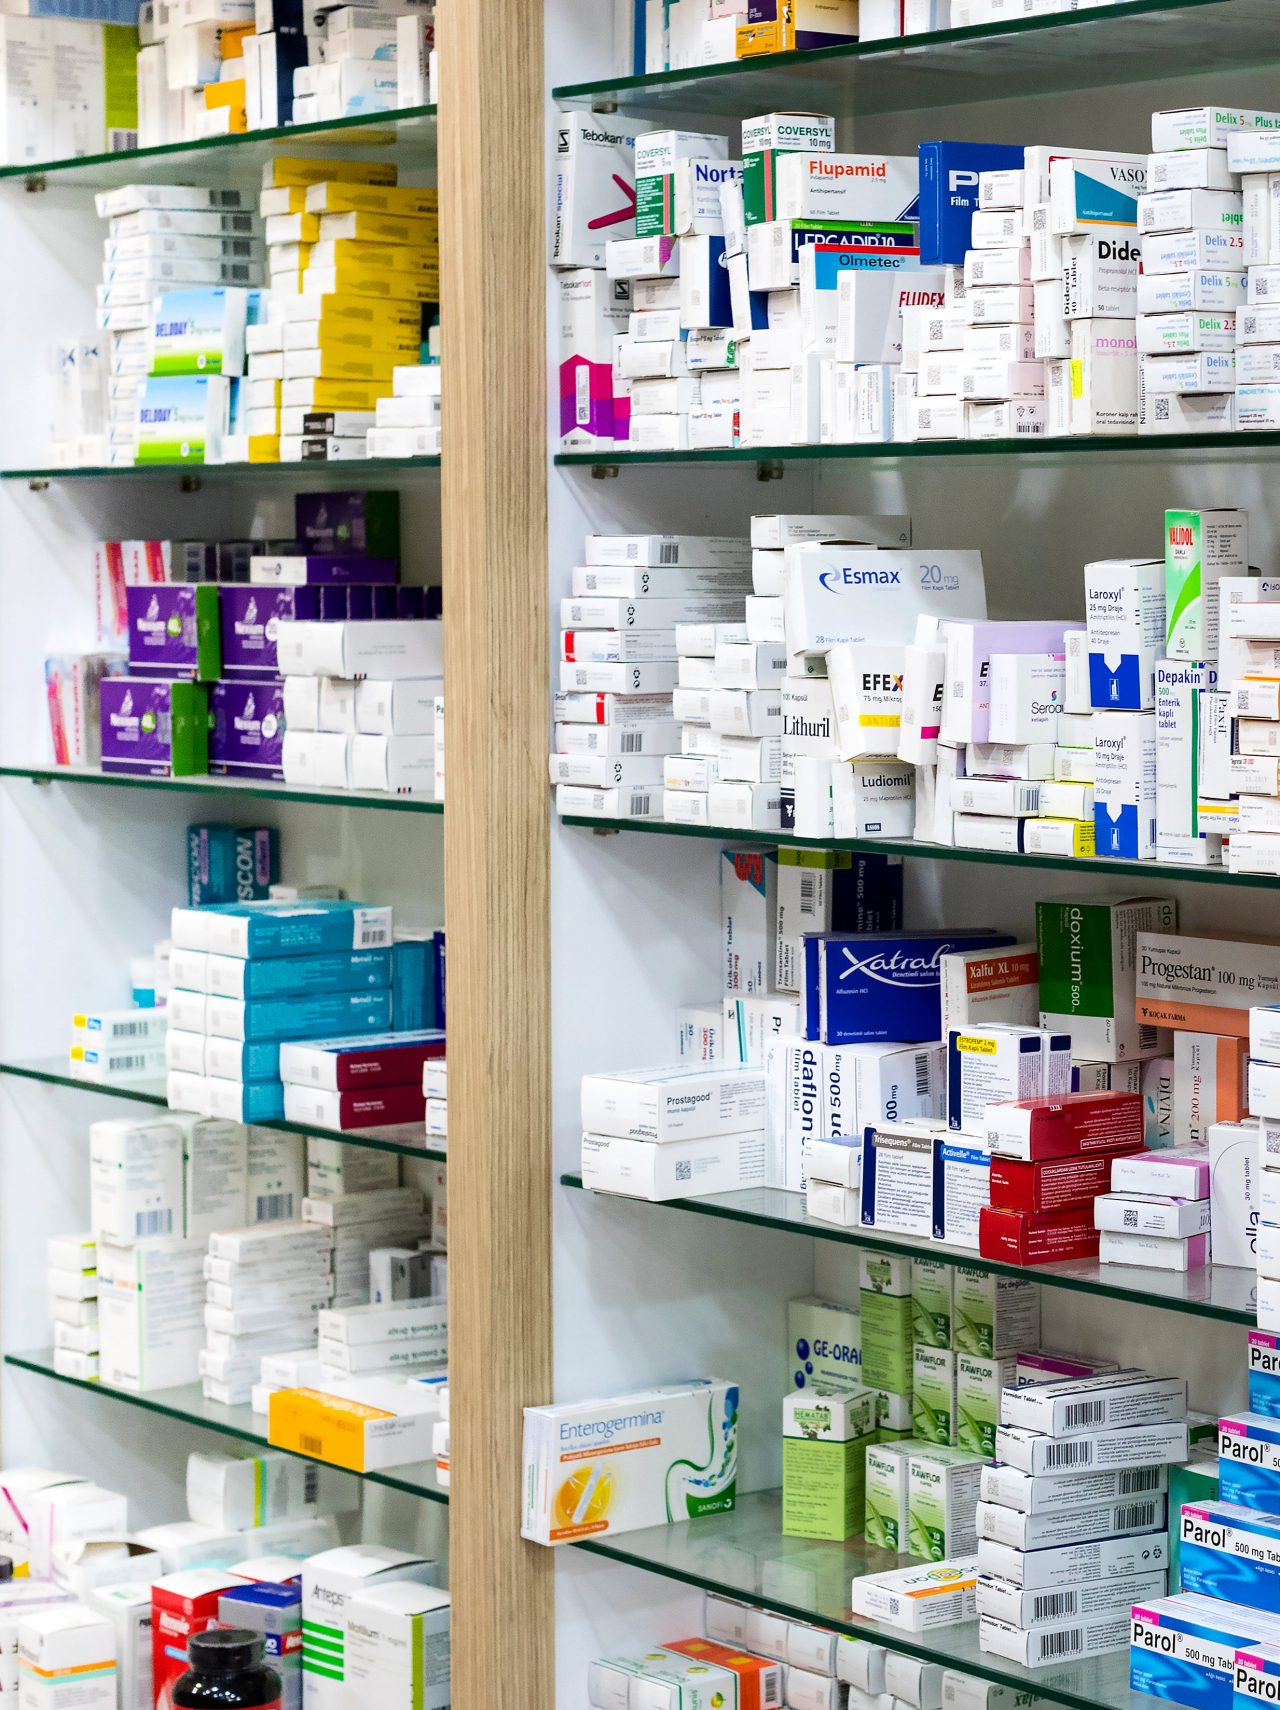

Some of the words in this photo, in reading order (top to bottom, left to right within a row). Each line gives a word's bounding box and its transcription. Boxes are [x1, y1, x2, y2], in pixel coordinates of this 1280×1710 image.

[1215, 112, 1237, 125] Delix
[1240, 115, 1245, 125] 5
[1255, 116, 1272, 128] Plus
[581, 129, 623, 145] Tebokan
[777, 125, 831, 137] COVERSYL
[809, 138, 817, 147] 10
[819, 140, 831, 149] mg
[636, 147, 671, 160] COVERSYL
[809, 160, 886, 178] Flupamid
[950, 196, 969, 206] Film
[553, 214, 562, 259] Tebokan
[1205, 235, 1227, 246] Delix
[1229, 237, 1243, 248] 2.5
[1098, 240, 1141, 261] Dide
[839, 254, 901, 268] Olmetec
[1200, 275, 1222, 287] Delix
[1225, 276, 1231, 287] 5
[1063, 267, 1071, 315] Dideral
[1199, 318, 1221, 330] Delix
[1206, 356, 1229, 367] Delix
[842, 567, 901, 585] Esmax
[919, 564, 942, 584] 20
[943, 574, 959, 586] mg
[1089, 587, 1122, 601] Laroxyl
[1089, 604, 1097, 612] 25
[1098, 605, 1106, 614] mg
[1108, 604, 1123, 614] Draje
[815, 635, 825, 644] 28
[862, 673, 904, 692] EFEX
[1158, 669, 1200, 686] Depakin
[1158, 687, 1169, 696] 500
[1158, 697, 1181, 707] Enterik
[1158, 708, 1174, 719] kaplı
[1218, 698, 1228, 734] Paxil
[783, 714, 831, 738] Lithuril
[1158, 720, 1177, 729] tablet
[1095, 736, 1123, 749] Laroxyl
[1111, 753, 1125, 761] Draje
[861, 773, 911, 788] Ludiomil
[236, 837, 254, 901] SCON
[1070, 907, 1084, 983] doxium
[969, 963, 994, 979] Xalfu
[998, 961, 1010, 975] XL
[1011, 963, 1019, 972] 10
[1019, 963, 1030, 974] mg
[1141, 955, 1212, 982] Progestan
[1217, 970, 1236, 985] 100
[1239, 977, 1256, 991] mg
[1071, 985, 1081, 1006] 500
[1168, 1012, 1187, 1022] FARMA
[793, 1071, 801, 1112] tablet
[801, 1049, 814, 1133] daflon
[1192, 1074, 1202, 1096] mg
[666, 1092, 711, 1107] Prostagood
[1191, 1097, 1200, 1124] 200
[874, 1134, 909, 1148] Trisequens
[942, 1148, 967, 1159] Activelle
[1245, 1175, 1252, 1188] mg
[1244, 1189, 1251, 1201] 30
[915, 1351, 946, 1368] RAWFLOR
[960, 1363, 993, 1379] RAWFLOR
[559, 1410, 663, 1440] Enterogermina
[1221, 1435, 1264, 1464] Parol
[868, 1457, 895, 1474] RAWFLOR
[911, 1468, 941, 1485] RAWFLOR
[1183, 1518, 1226, 1548] Parol
[1234, 1542, 1250, 1554] 500
[1251, 1548, 1264, 1561] mg
[1133, 1622, 1176, 1654] Parol
[1185, 1647, 1200, 1661] 500
[1202, 1654, 1215, 1667] mg
[1236, 1667, 1280, 1701] Parol
